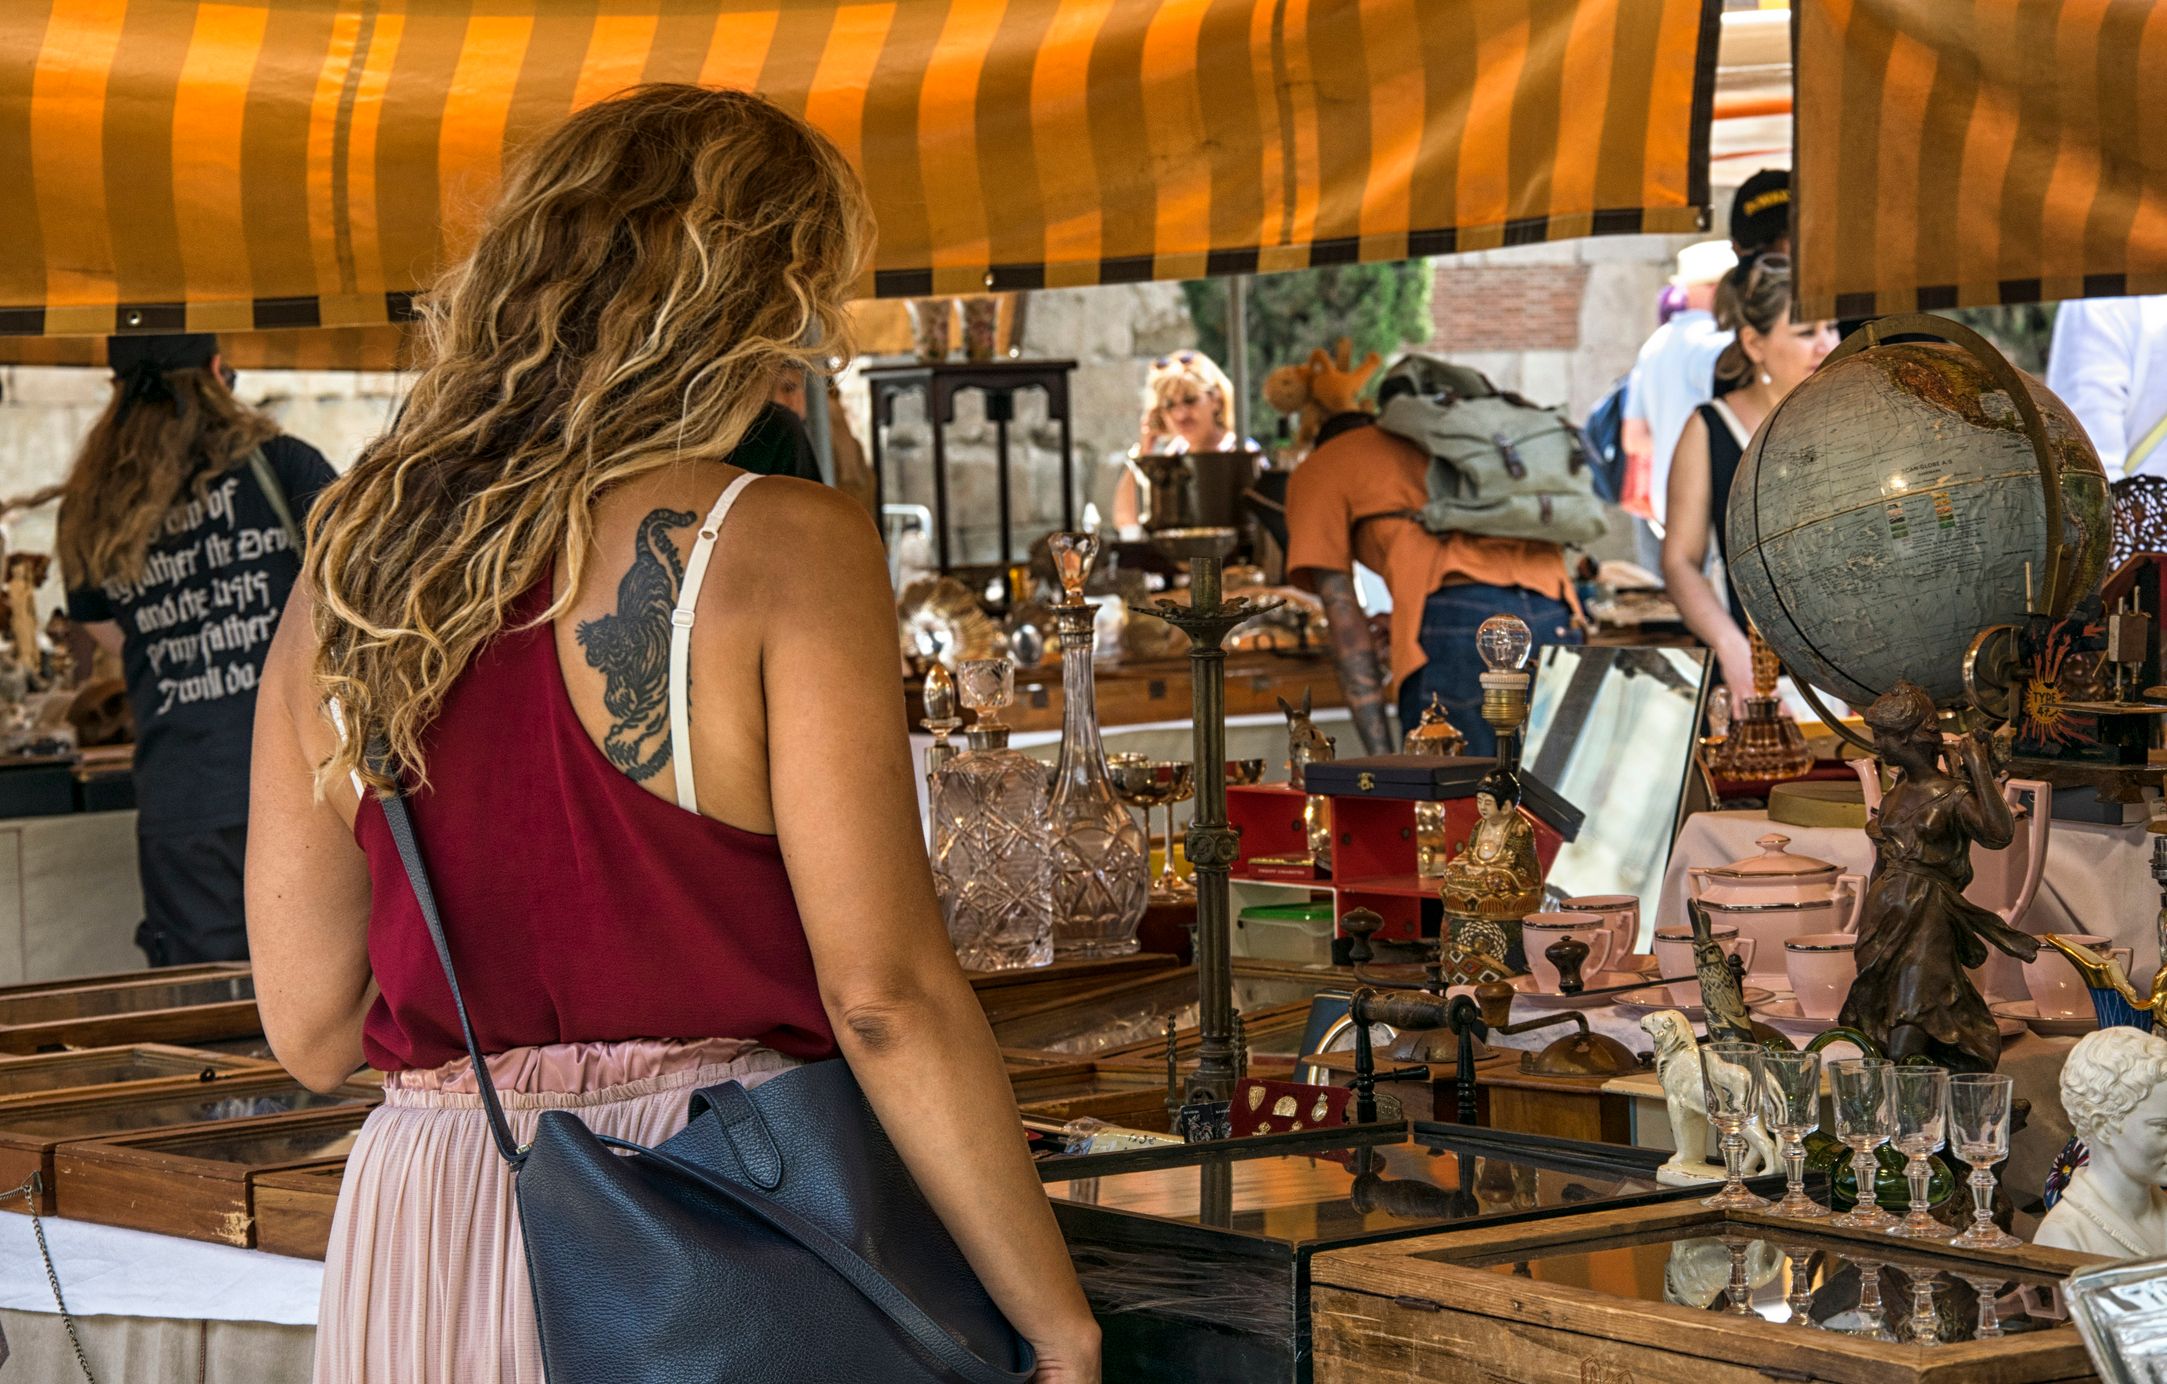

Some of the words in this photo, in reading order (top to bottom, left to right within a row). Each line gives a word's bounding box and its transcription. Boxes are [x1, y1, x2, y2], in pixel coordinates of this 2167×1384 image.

[207, 477, 239, 531] of
[205, 533, 235, 569] the
[237, 527, 293, 560] Dev
[135, 593, 178, 634] and
[178, 587, 210, 621] the
[200, 607, 279, 671] father
[178, 666, 225, 704] will
[2033, 691, 2056, 705] TYPE
